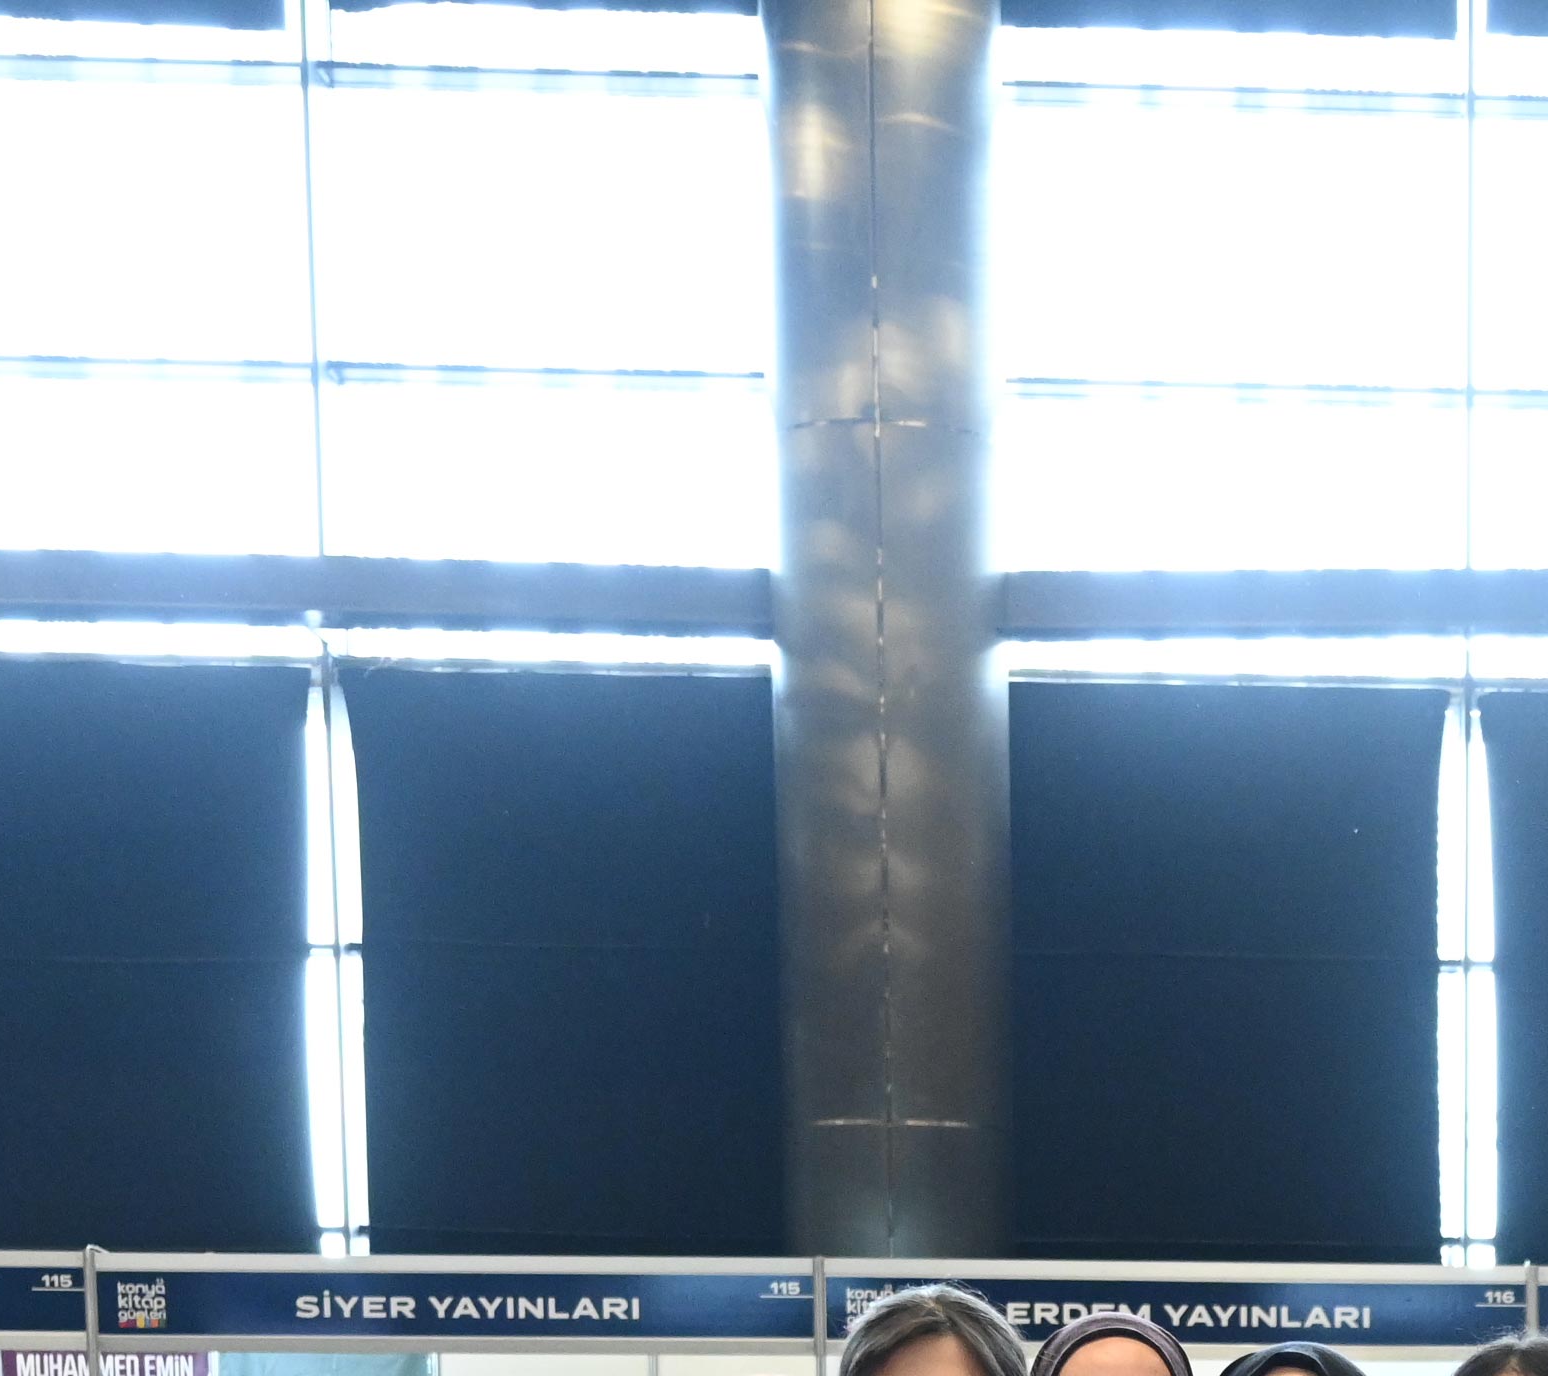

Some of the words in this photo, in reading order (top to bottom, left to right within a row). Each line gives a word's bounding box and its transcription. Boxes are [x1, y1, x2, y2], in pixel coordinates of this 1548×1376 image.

[41, 1274, 73, 1288] 115
[117, 1280, 166, 1298] konya
[769, 1281, 802, 1296] 115
[117, 1294, 166, 1311] kitap
[295, 1290, 416, 1320] SİYER
[428, 1297, 641, 1321] YAYINLARI
[1485, 1290, 1515, 1304] 116
[1163, 1304, 1373, 1331] YAYINLARI
